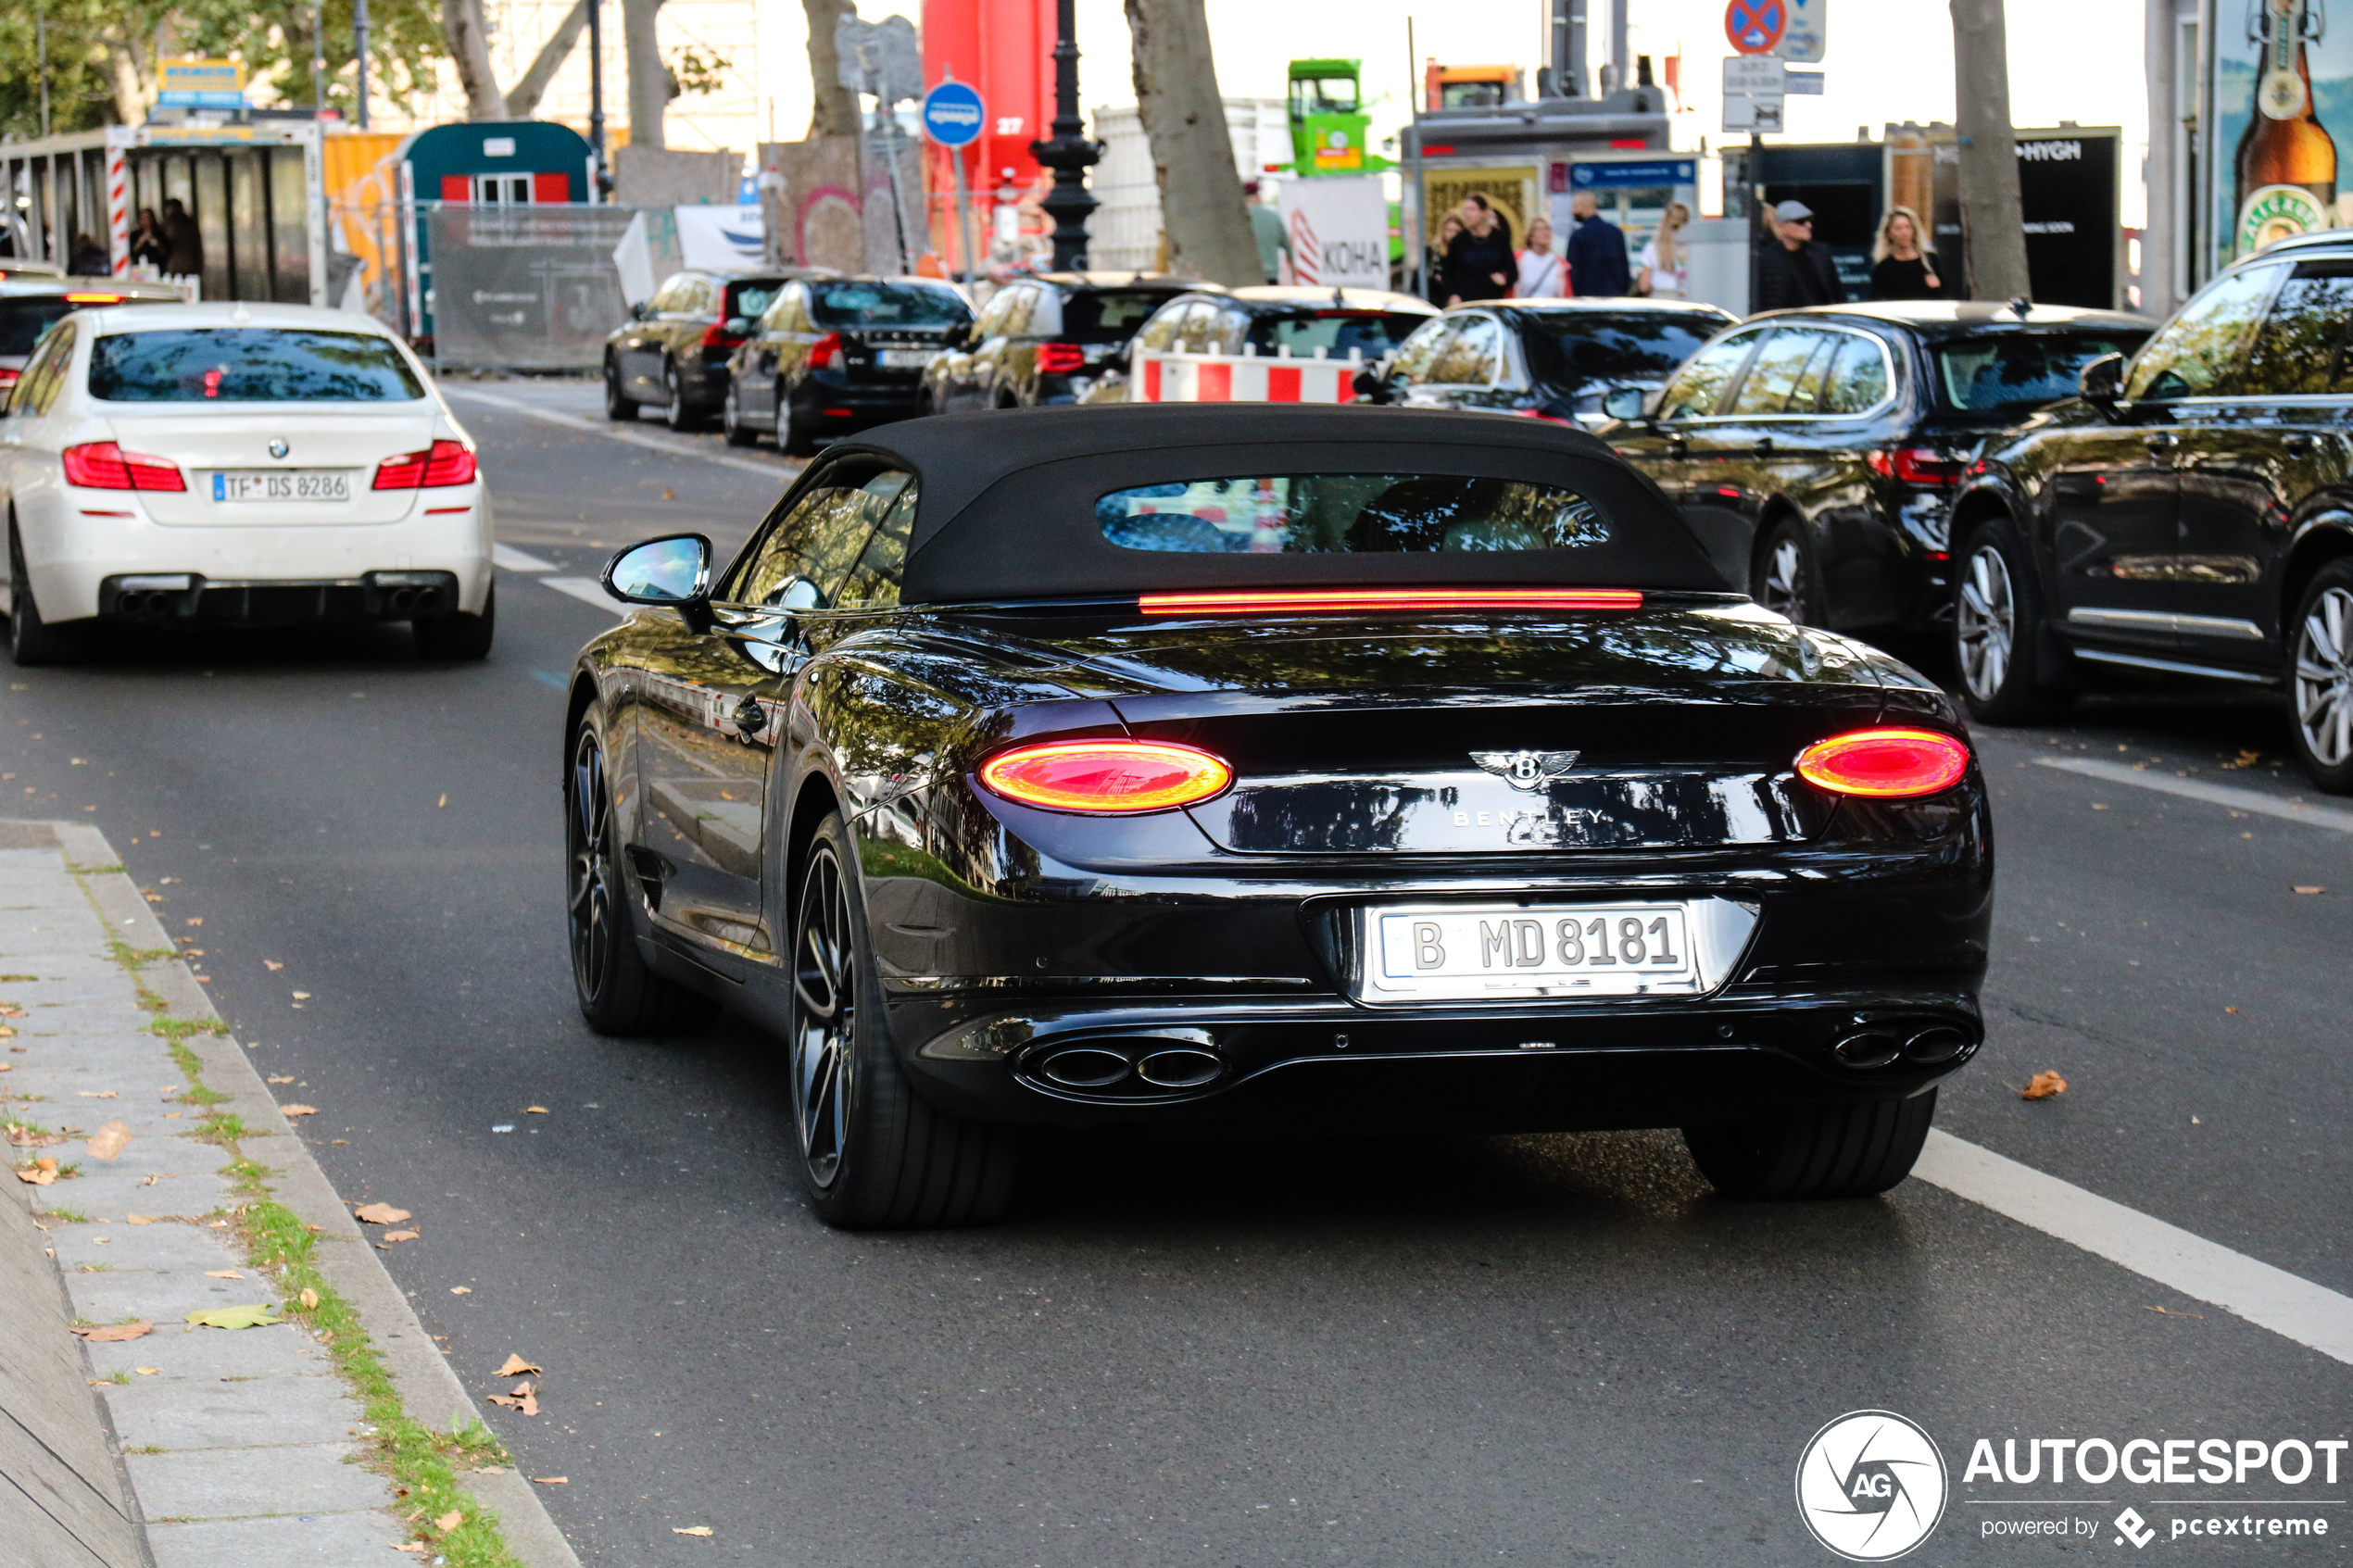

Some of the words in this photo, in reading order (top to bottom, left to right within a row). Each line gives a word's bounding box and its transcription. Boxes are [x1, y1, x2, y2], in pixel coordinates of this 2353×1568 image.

[997, 117, 1024, 135] 27
[2023, 140, 2082, 161] HYGH
[1323, 241, 1384, 274] KOHA
[227, 477, 249, 496] TF
[268, 476, 291, 496] DS
[298, 475, 346, 495] 8286
[1516, 759, 1537, 779] B
[1453, 809, 1603, 827] BENTLEY
[1413, 922, 1446, 970] B
[1479, 919, 1546, 968] MD
[1556, 916, 1679, 966] 8181
